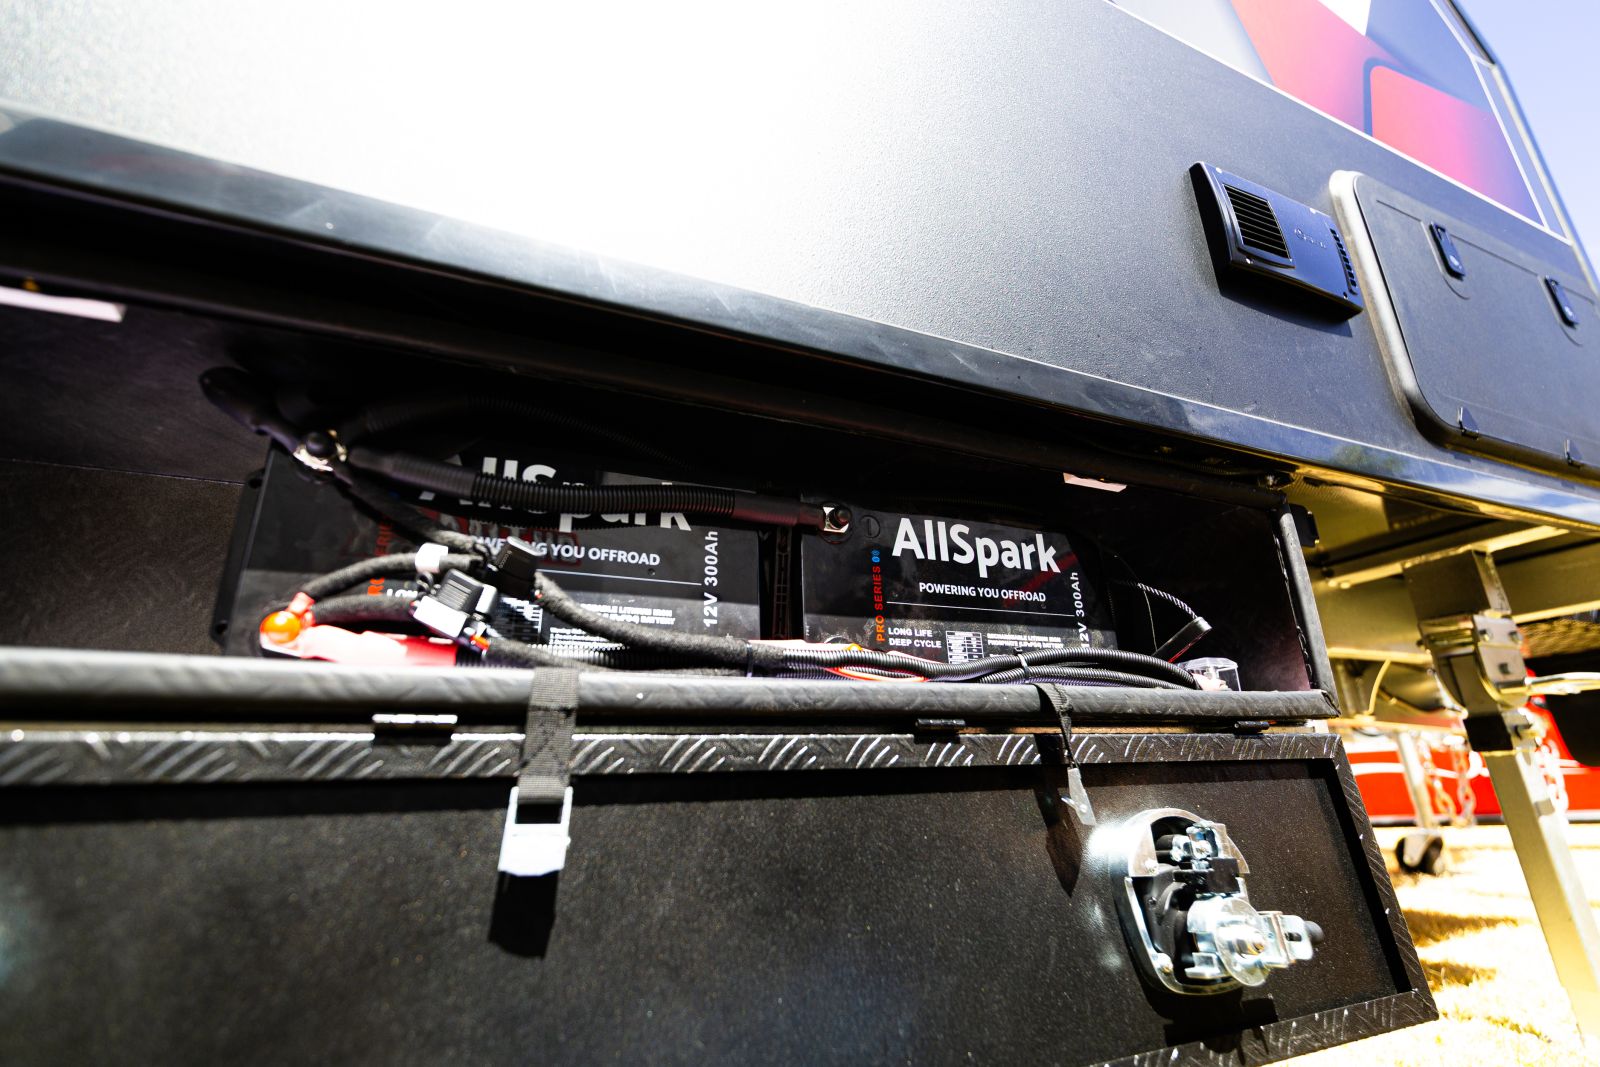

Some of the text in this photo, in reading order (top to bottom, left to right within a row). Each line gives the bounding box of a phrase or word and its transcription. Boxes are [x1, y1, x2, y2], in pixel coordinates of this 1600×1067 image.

[551, 544, 585, 559] YOU
[588, 547, 660, 566] OFFROAD
[892, 517, 1061, 579] AllSpark
[703, 531, 718, 627] 12V 300Ah
[873, 566, 883, 610] SERIES
[919, 582, 1046, 602] POWERING YOU OFFROAD
[1070, 572, 1085, 618] 300Ah
[876, 614, 885, 642] PRO
[888, 627, 933, 638] LONG LIFE
[889, 637, 942, 648] DEEP CYCLE
